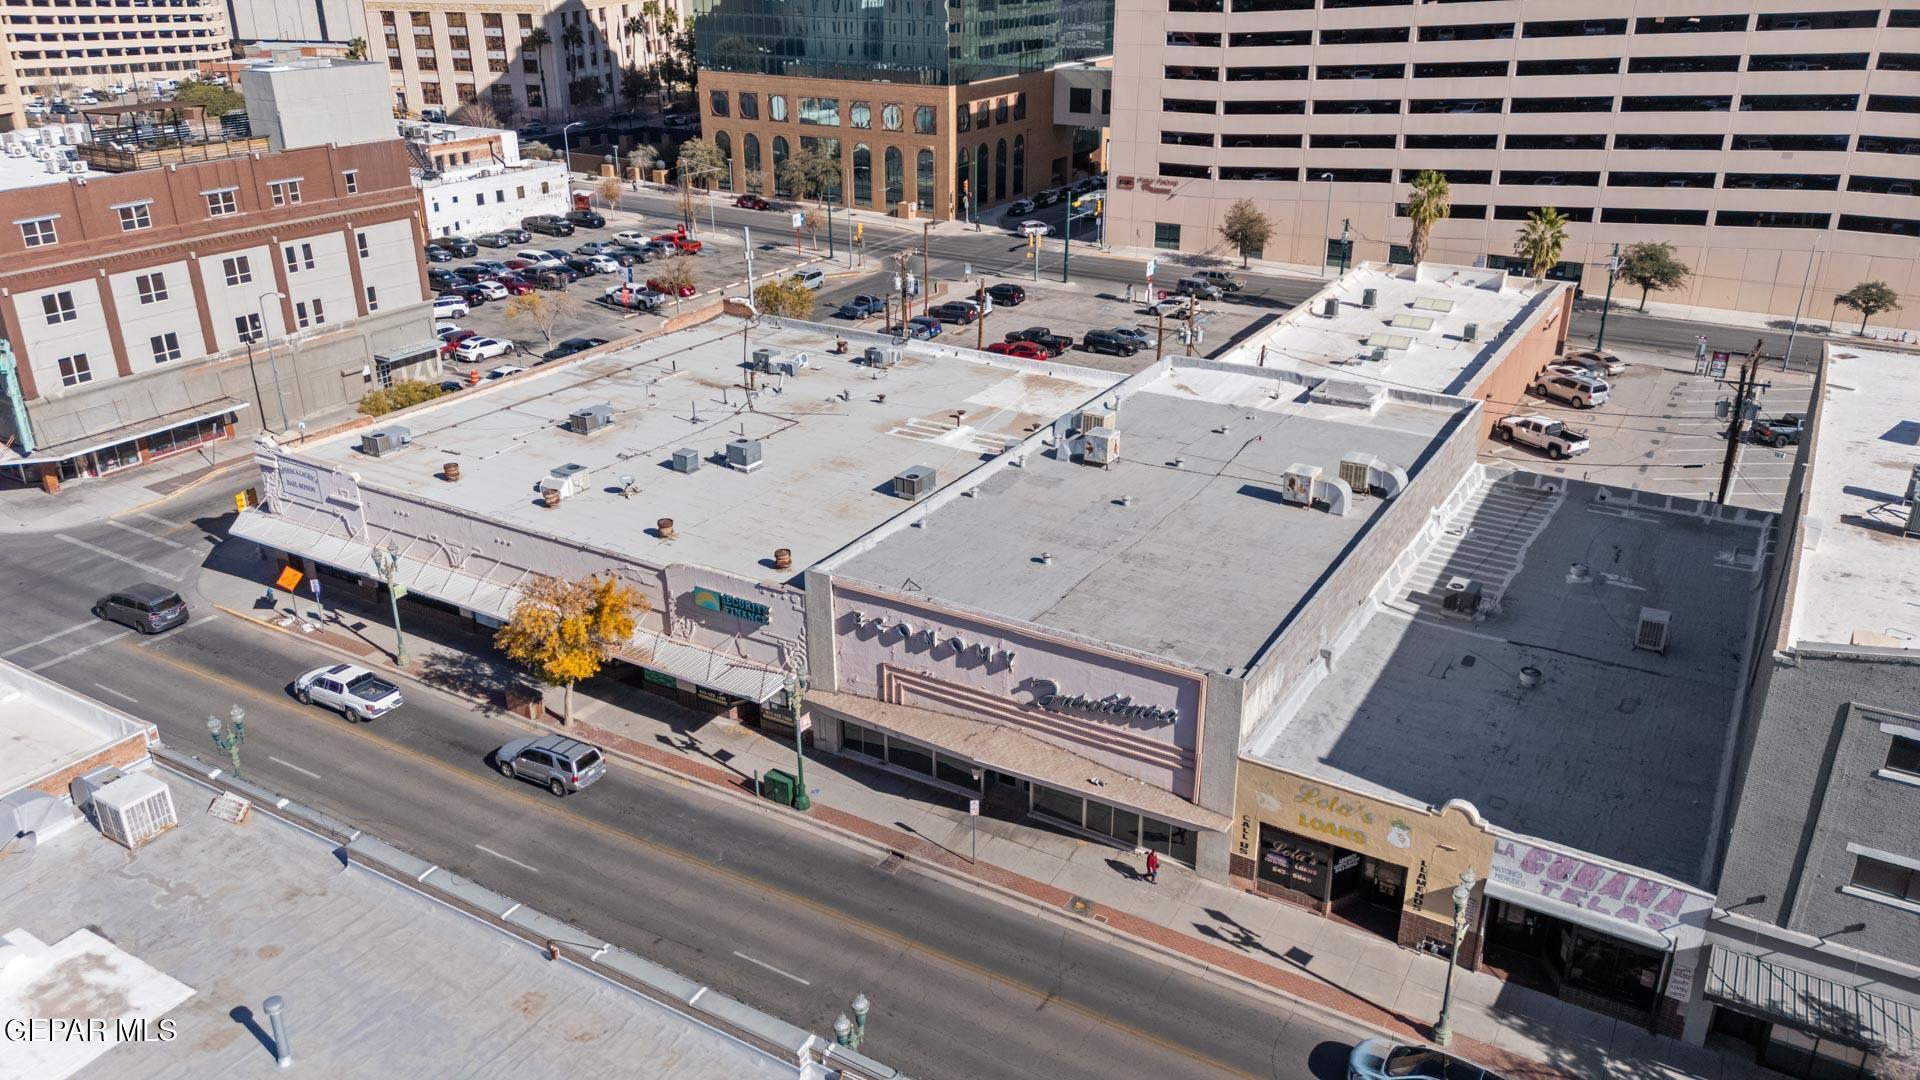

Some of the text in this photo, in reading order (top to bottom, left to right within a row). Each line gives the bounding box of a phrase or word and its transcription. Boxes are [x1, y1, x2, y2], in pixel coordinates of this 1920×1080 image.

[721, 594, 770, 614] SECURITY
[726, 607, 770, 625] FINANCE
[1241, 814, 1251, 840] CALL
[1298, 813, 1366, 845] LOANS
[1493, 838, 1515, 859] LA
[1538, 879, 1672, 930] TELAS
